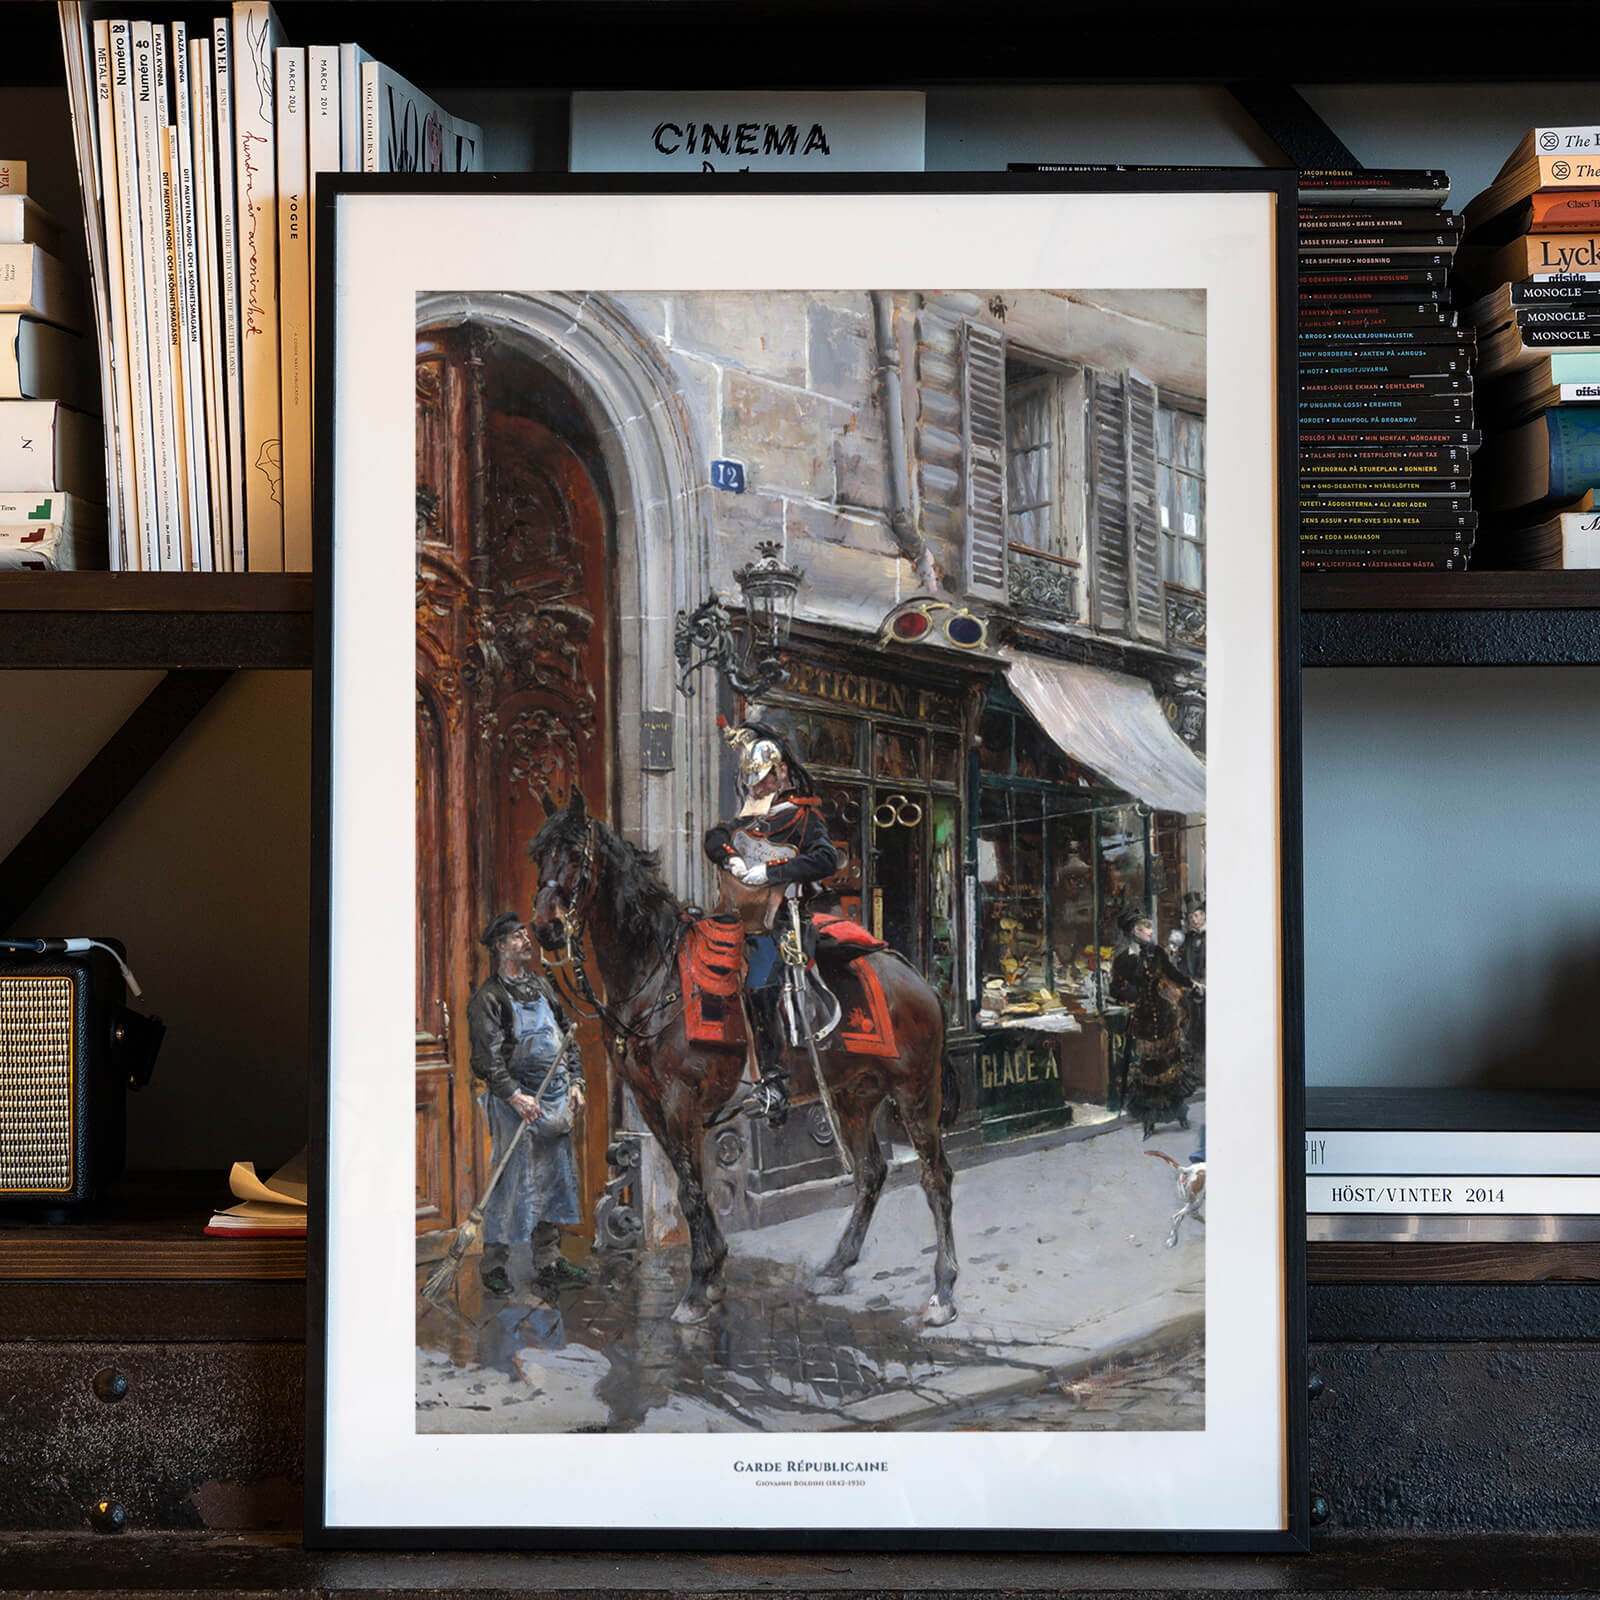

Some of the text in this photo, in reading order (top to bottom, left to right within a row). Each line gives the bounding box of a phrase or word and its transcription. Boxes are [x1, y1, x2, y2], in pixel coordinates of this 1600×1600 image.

[112, 25, 126, 34] 29
[136, 40, 150, 49] 40
[116, 38, 127, 86] Numéro
[216, 27, 227, 74] COVER
[97, 47, 109, 100] METAL #22
[139, 54, 151, 102] Numéro
[156, 58, 164, 87] KVINNA
[320, 59, 328, 116] MARCH 2014
[651, 121, 831, 155] CINEMA
[1565, 135, 1591, 148] The
[242, 131, 268, 192] hundra
[162, 171, 170, 187] DITT
[163, 188, 172, 228] MEDVETNA
[184, 184, 192, 224] MEDVETNA
[290, 194, 298, 240] VOGUE
[1567, 200, 1590, 209] Claes
[187, 252, 195, 268] OCH
[1523, 288, 1582, 297] MONOCLE
[1548, 273, 1586, 282] offside
[168, 273, 177, 345] SKÖNHETSMAGASIN
[188, 270, 198, 343] SKÖNHETSMAGASIN
[1527, 312, 1586, 321] MONOCLE
[1532, 331, 1591, 340] MONOCLE
[717, 464, 739, 487] 12
[981, 1050, 1039, 1089] GLACE
[1331, 1184, 1505, 1203] HÖST/VINTER 2014
